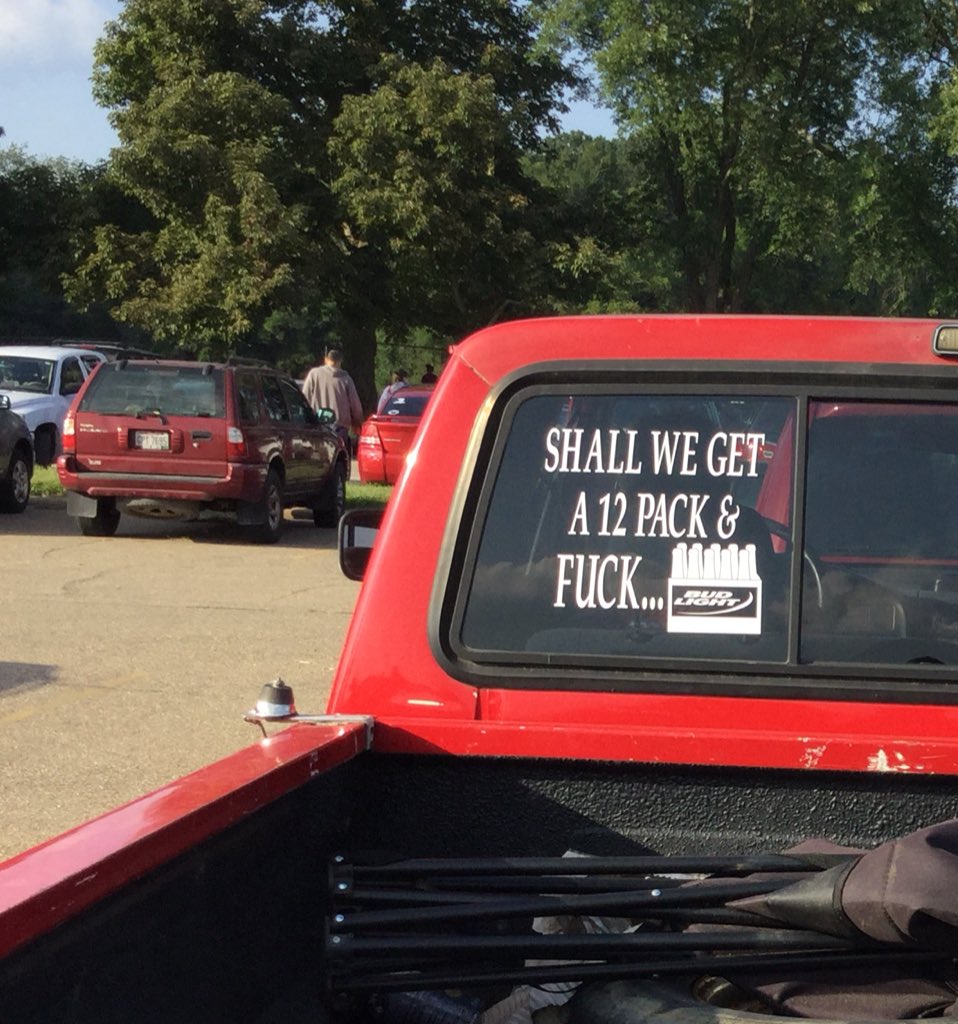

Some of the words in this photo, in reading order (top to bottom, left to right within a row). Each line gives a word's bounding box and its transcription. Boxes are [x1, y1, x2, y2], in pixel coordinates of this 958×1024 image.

[544, 427, 642, 474] SHALL
[651, 430, 699, 476] WE
[707, 432, 765, 477] GET
[568, 491, 590, 536] A
[598, 492, 627, 537] 12
[634, 493, 709, 538] PACK
[716, 495, 740, 539] &
[553, 554, 664, 611] FUCK...
[673, 597, 741, 607] LIGHT
[683, 590, 733, 599] BUD
